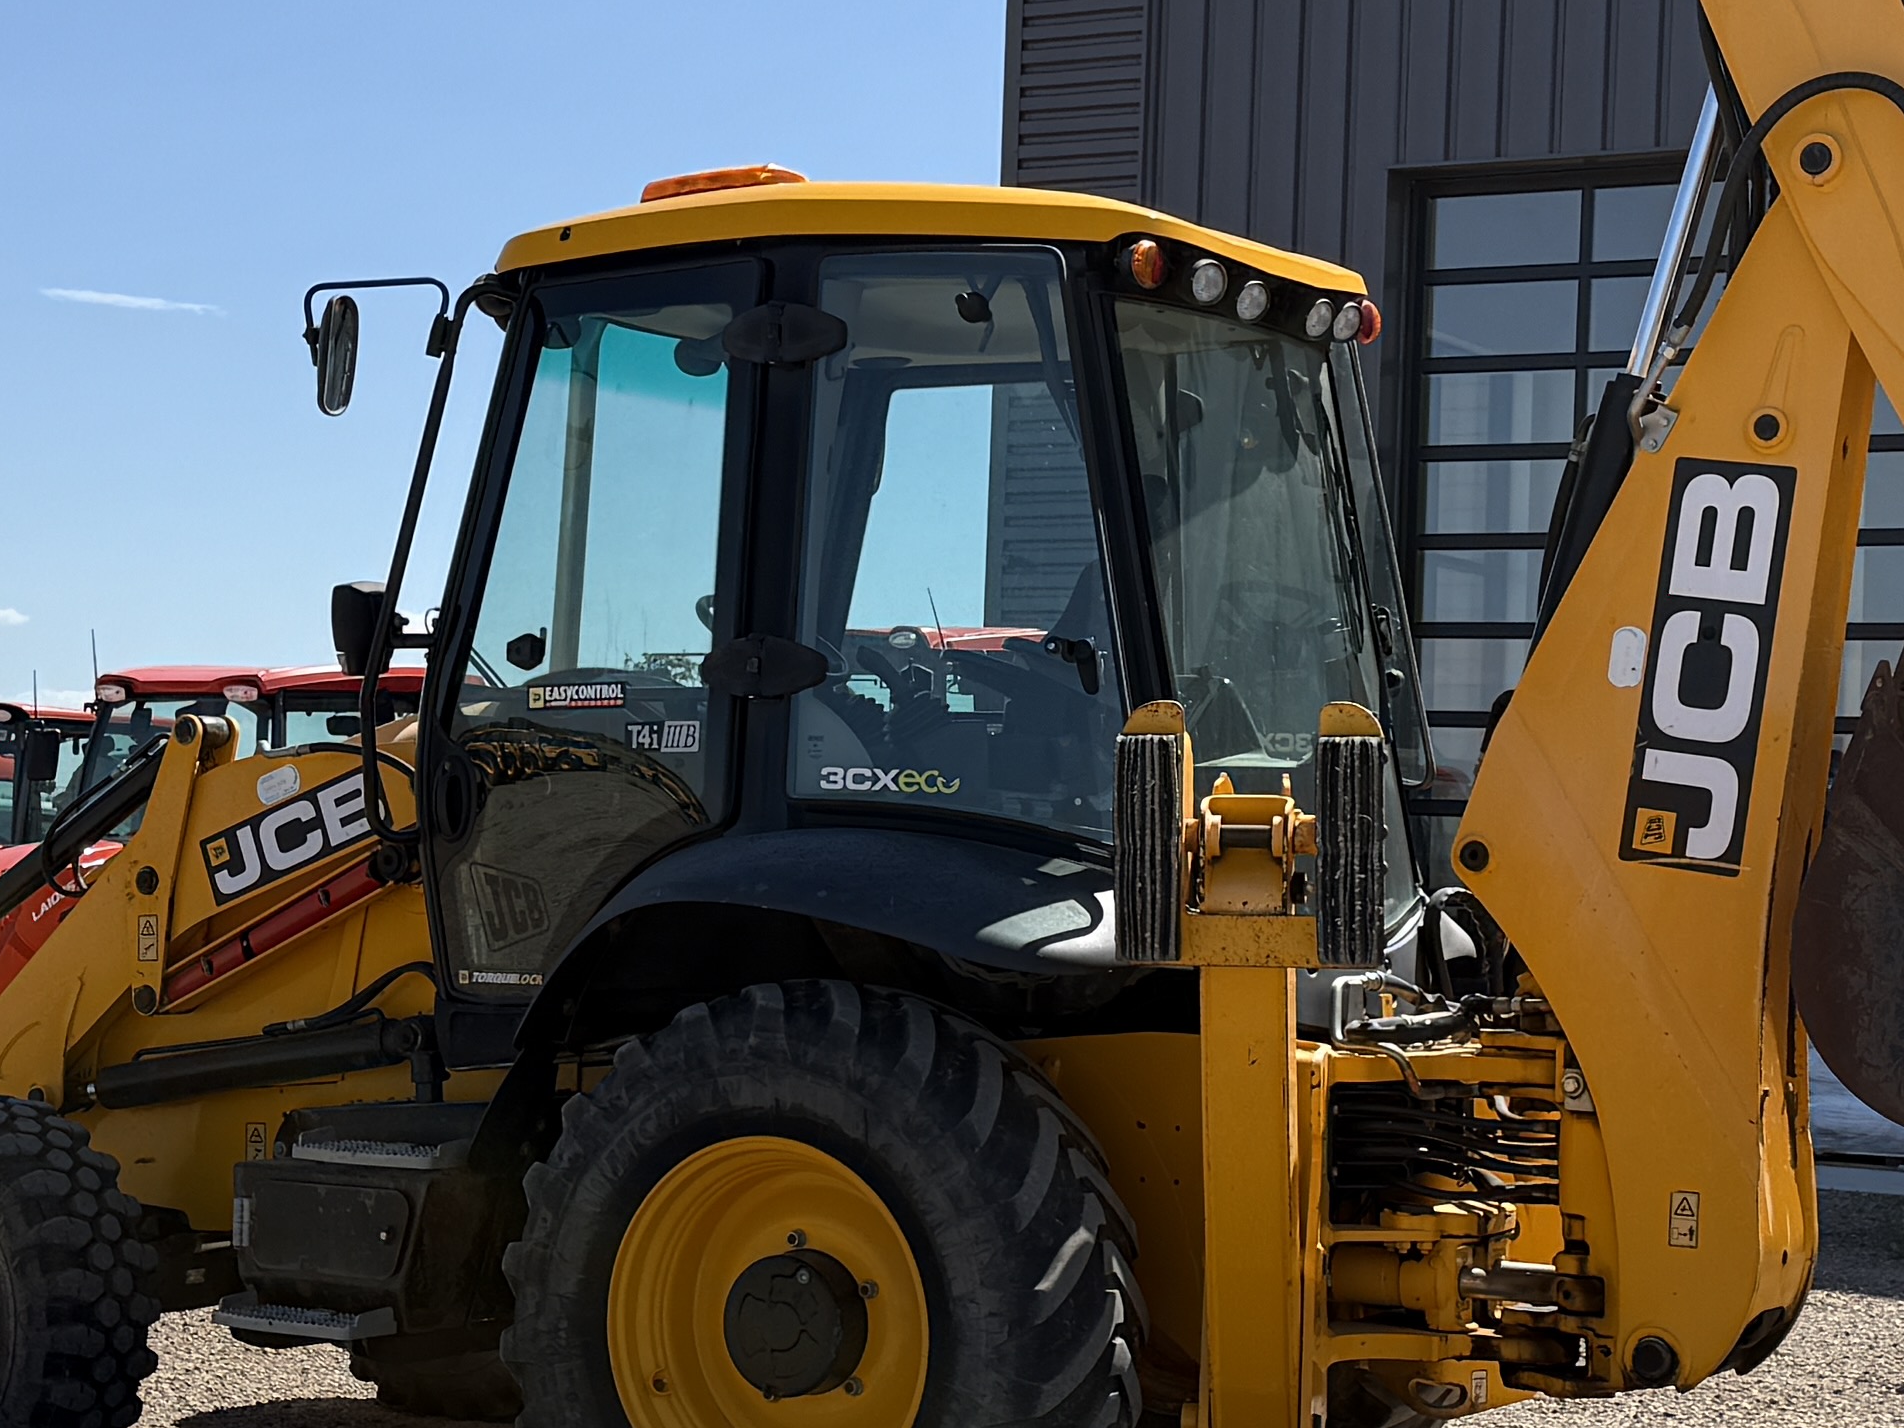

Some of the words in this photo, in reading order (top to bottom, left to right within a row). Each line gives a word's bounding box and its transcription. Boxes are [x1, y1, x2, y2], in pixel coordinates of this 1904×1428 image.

[545, 683, 624, 703] EASYCONTROL
[1642, 473, 1780, 860] JCB
[482, 871, 546, 943] JCB
